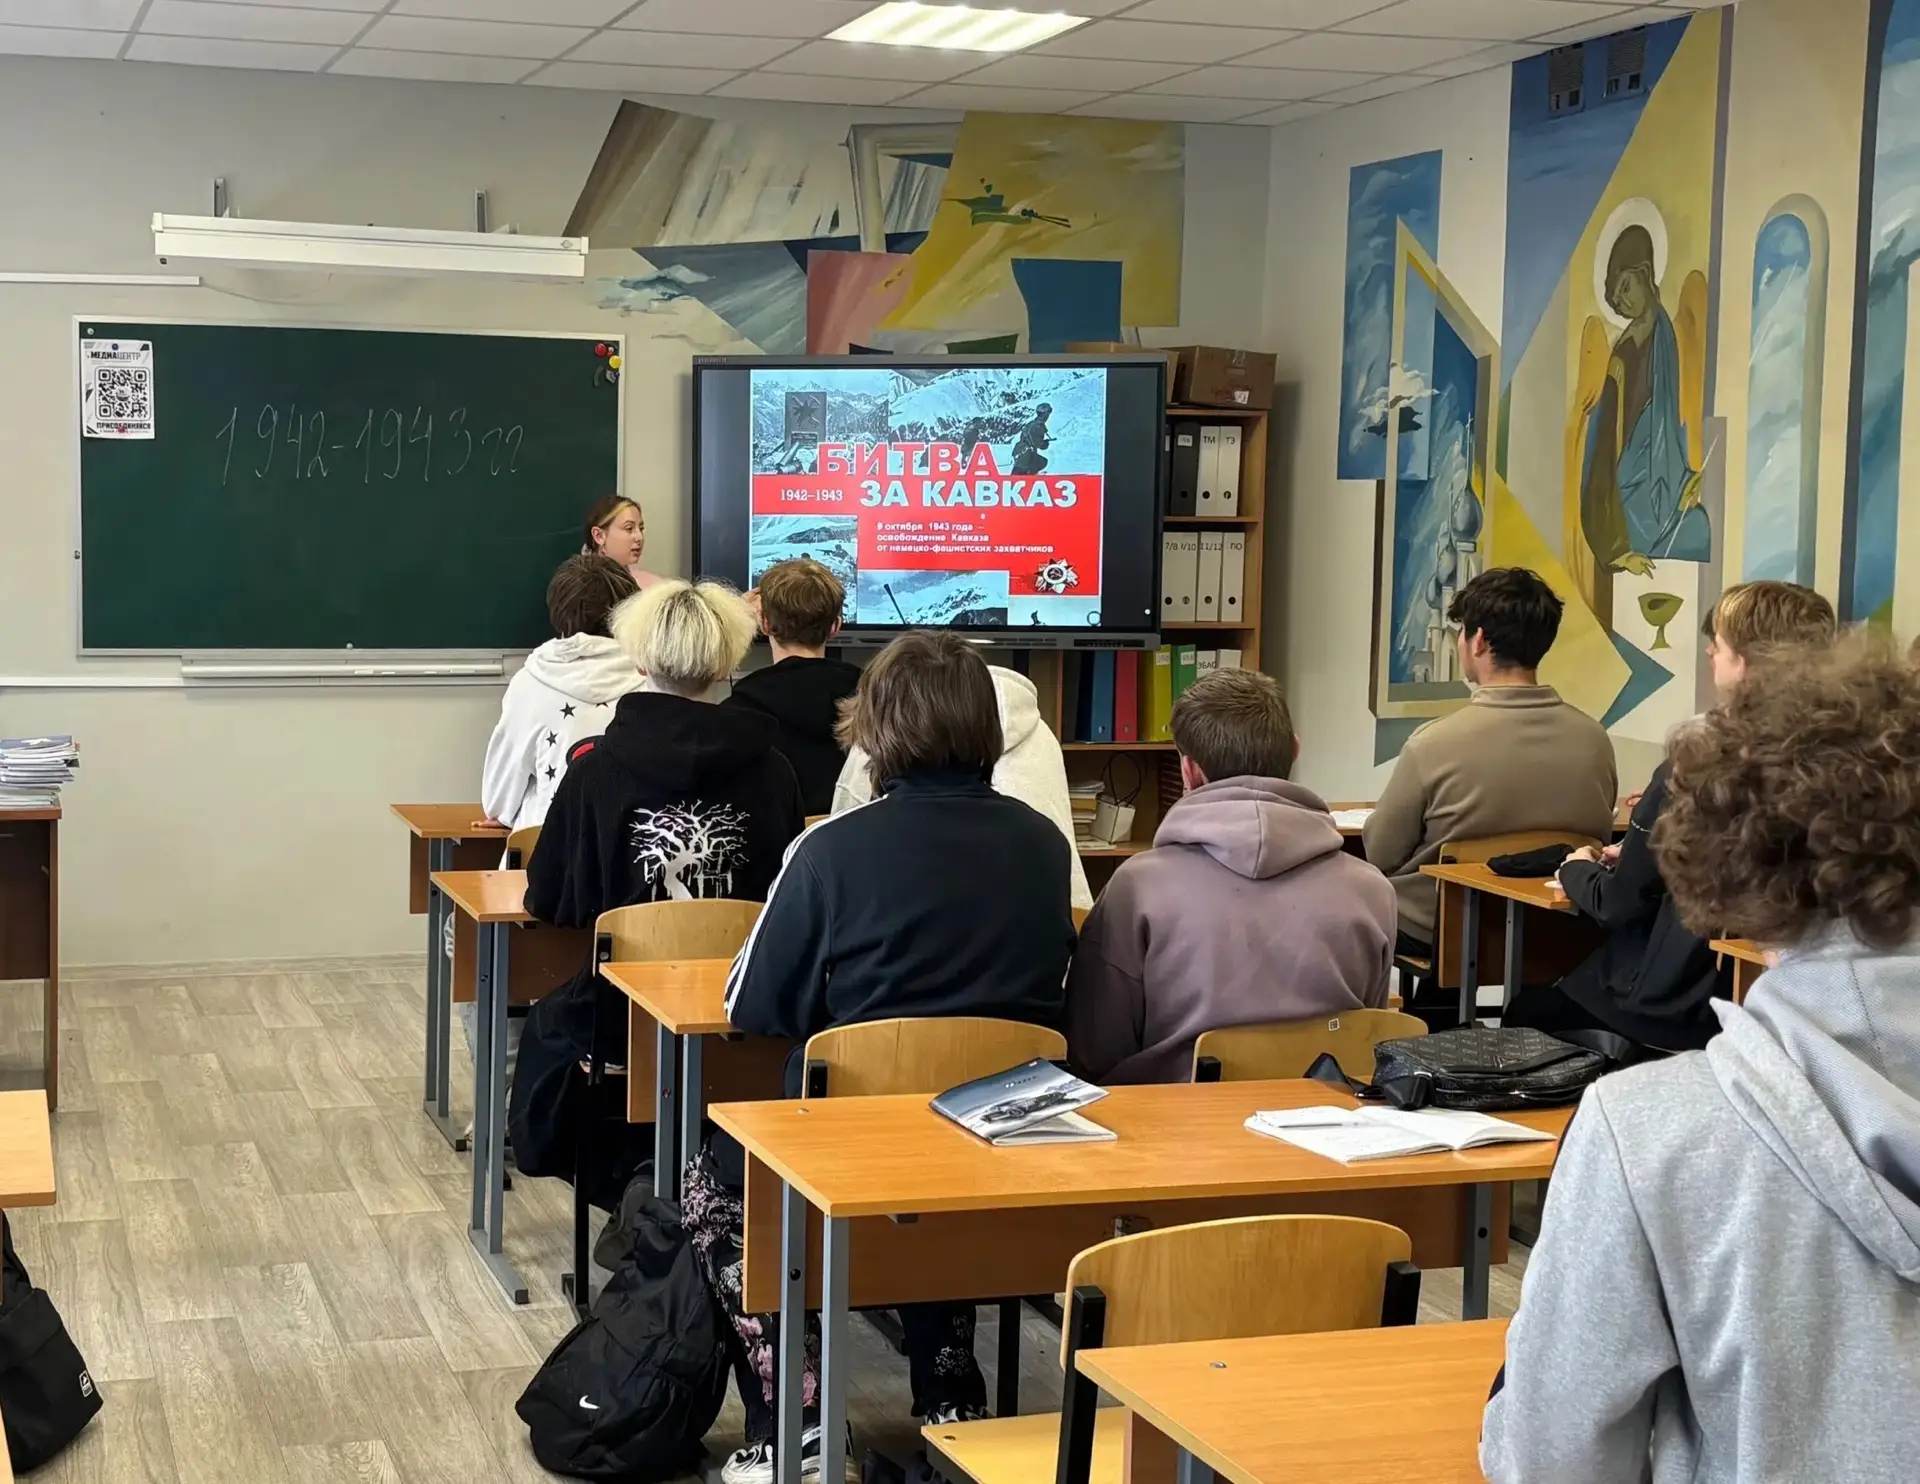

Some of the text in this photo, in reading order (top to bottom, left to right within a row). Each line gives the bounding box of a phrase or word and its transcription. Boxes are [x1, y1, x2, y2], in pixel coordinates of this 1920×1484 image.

[91, 351, 141, 360] МЕДИАЦЕНТР
[817, 442, 1001, 476] БИТВА
[859, 480, 1078, 507] ЗА КАВКАЗ
[884, 523, 924, 533] октября
[928, 522, 950, 531] 1943
[952, 523, 974, 532] года
[876, 533, 990, 543] освобождение Кавказа
[890, 544, 991, 554] немецко-фашистских
[994, 545, 1054, 554] захватчиков
